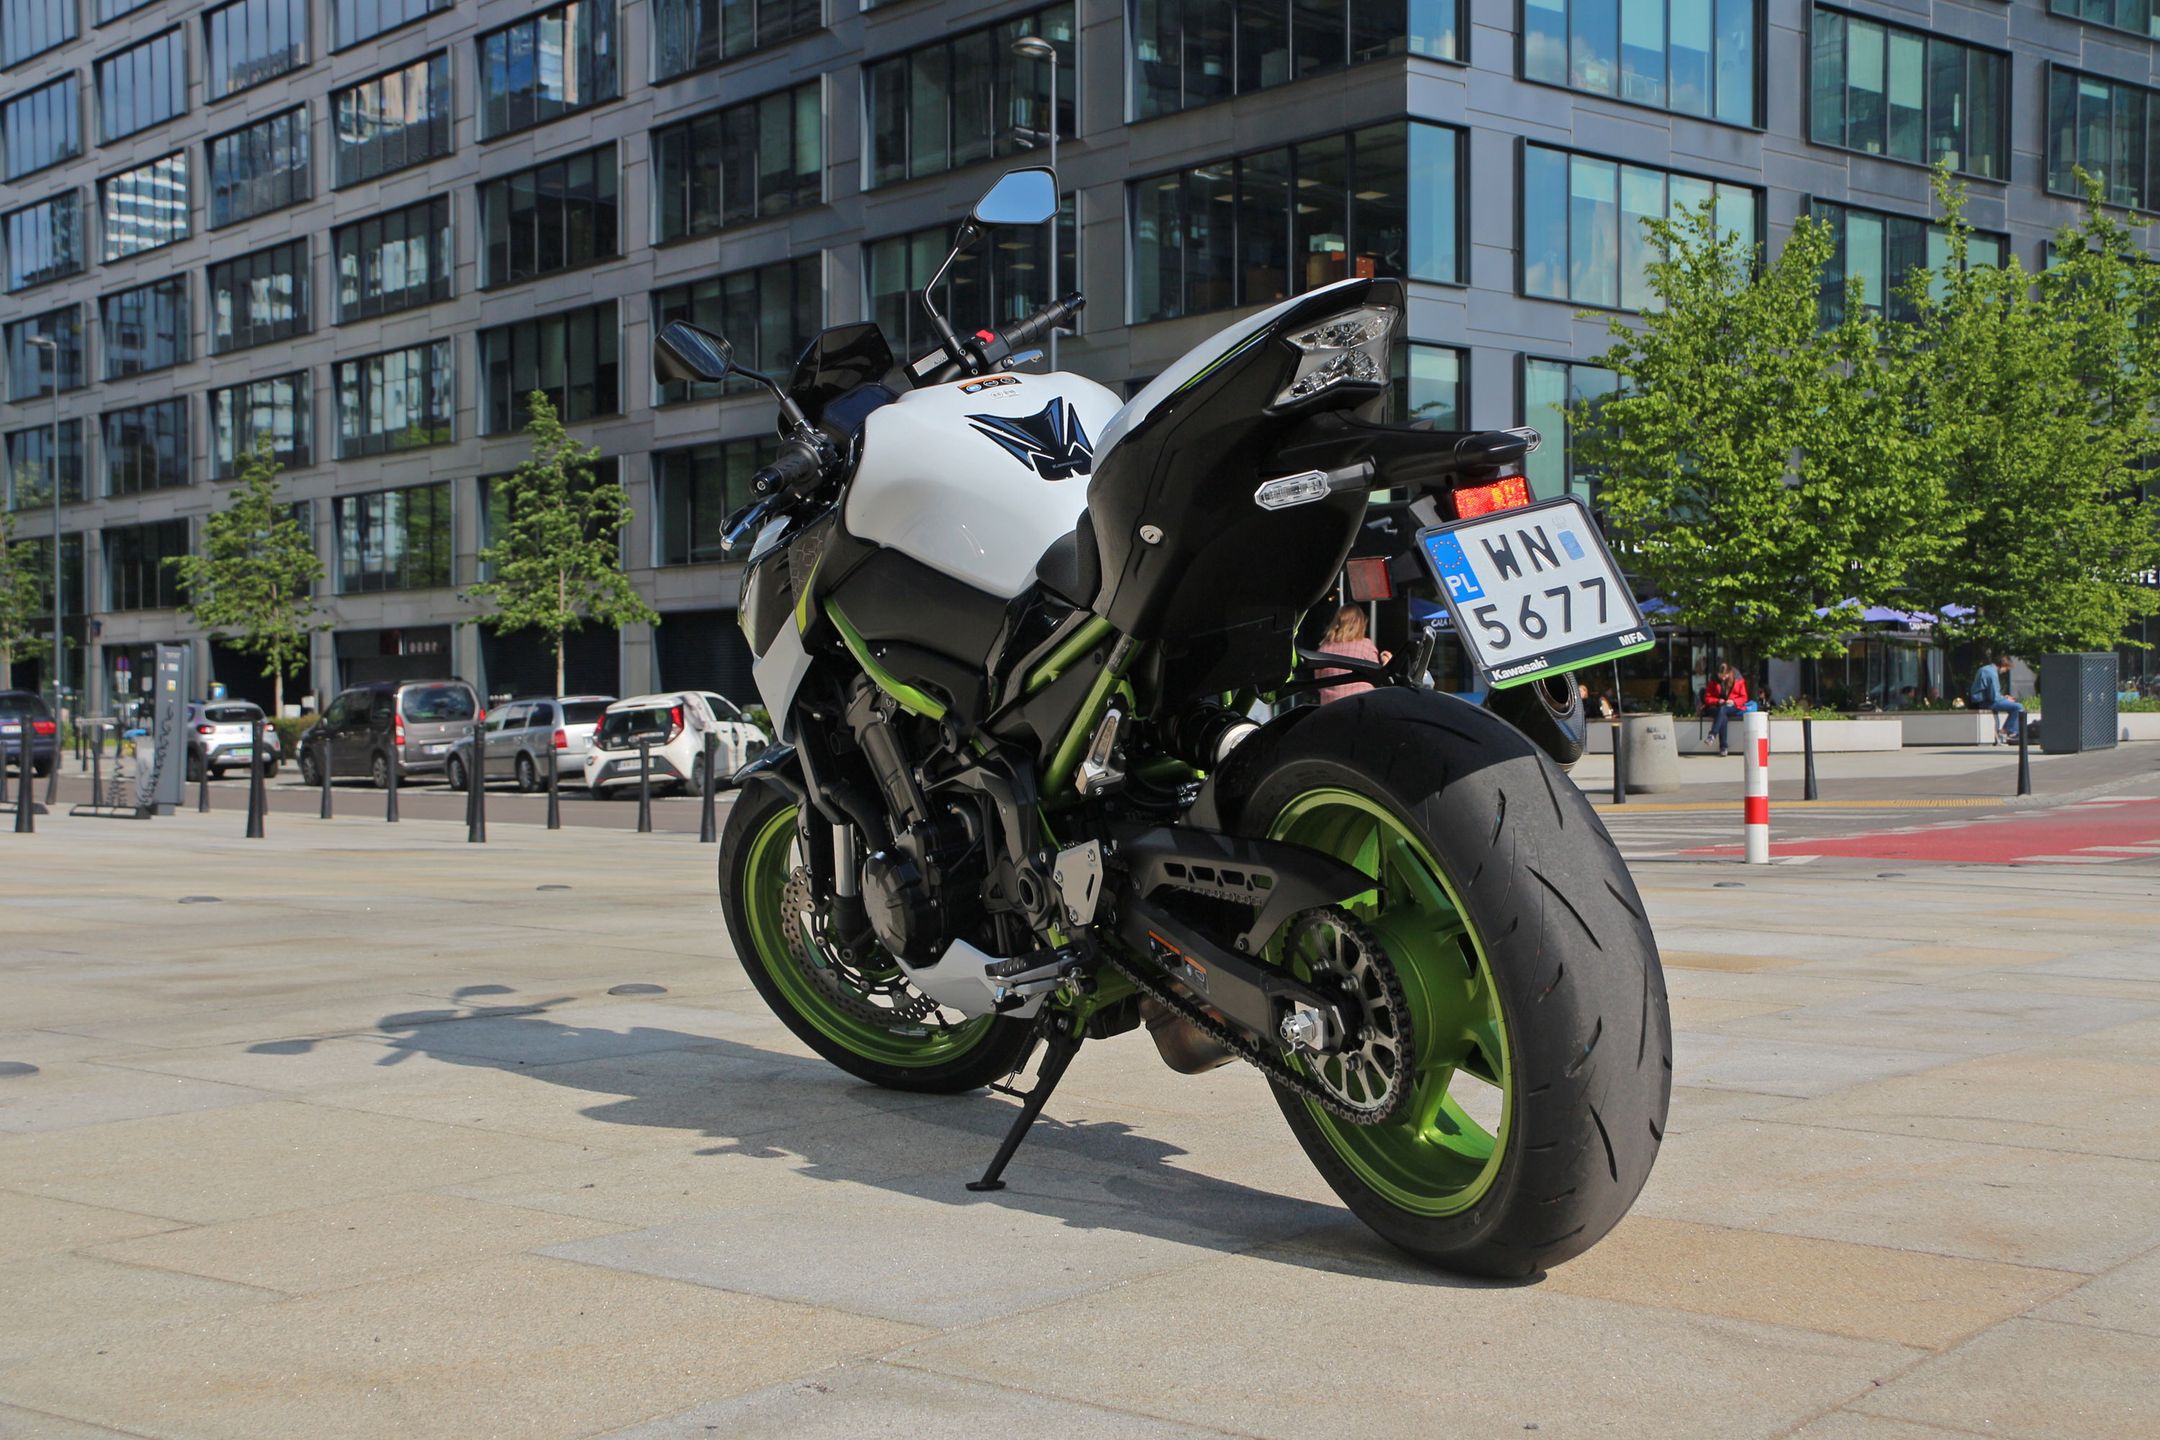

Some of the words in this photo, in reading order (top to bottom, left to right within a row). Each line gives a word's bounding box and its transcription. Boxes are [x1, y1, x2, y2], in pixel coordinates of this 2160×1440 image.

[1481, 525, 1560, 580] WN
[1446, 573, 1479, 597] PL
[1473, 576, 1607, 650] 5677
[1618, 631, 1647, 646] MFA
[1491, 656, 1549, 680] Kawasaki
